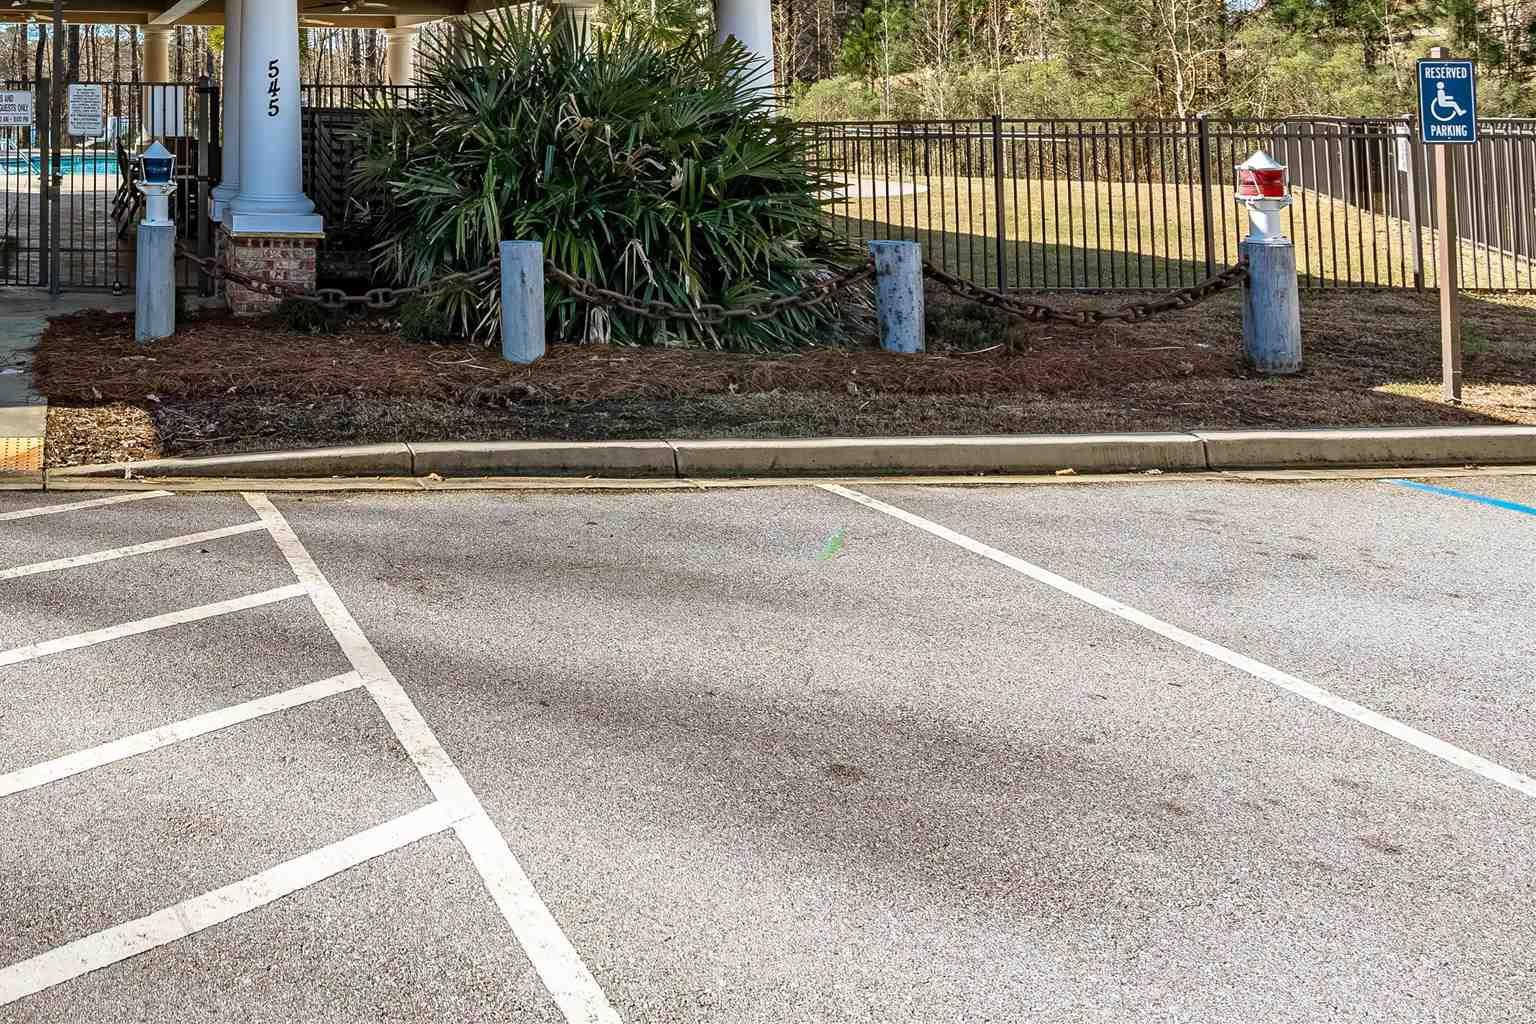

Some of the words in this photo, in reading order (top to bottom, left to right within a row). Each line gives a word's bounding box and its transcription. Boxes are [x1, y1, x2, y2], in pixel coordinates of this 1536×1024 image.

[1424, 66, 1467, 79] RESERVED
[267, 59, 281, 117] 545
[4, 94, 14, 102] AND
[0, 104, 17, 112] GUESTS
[17, 104, 29, 112] ONLY
[1430, 124, 1468, 137] PARKING
